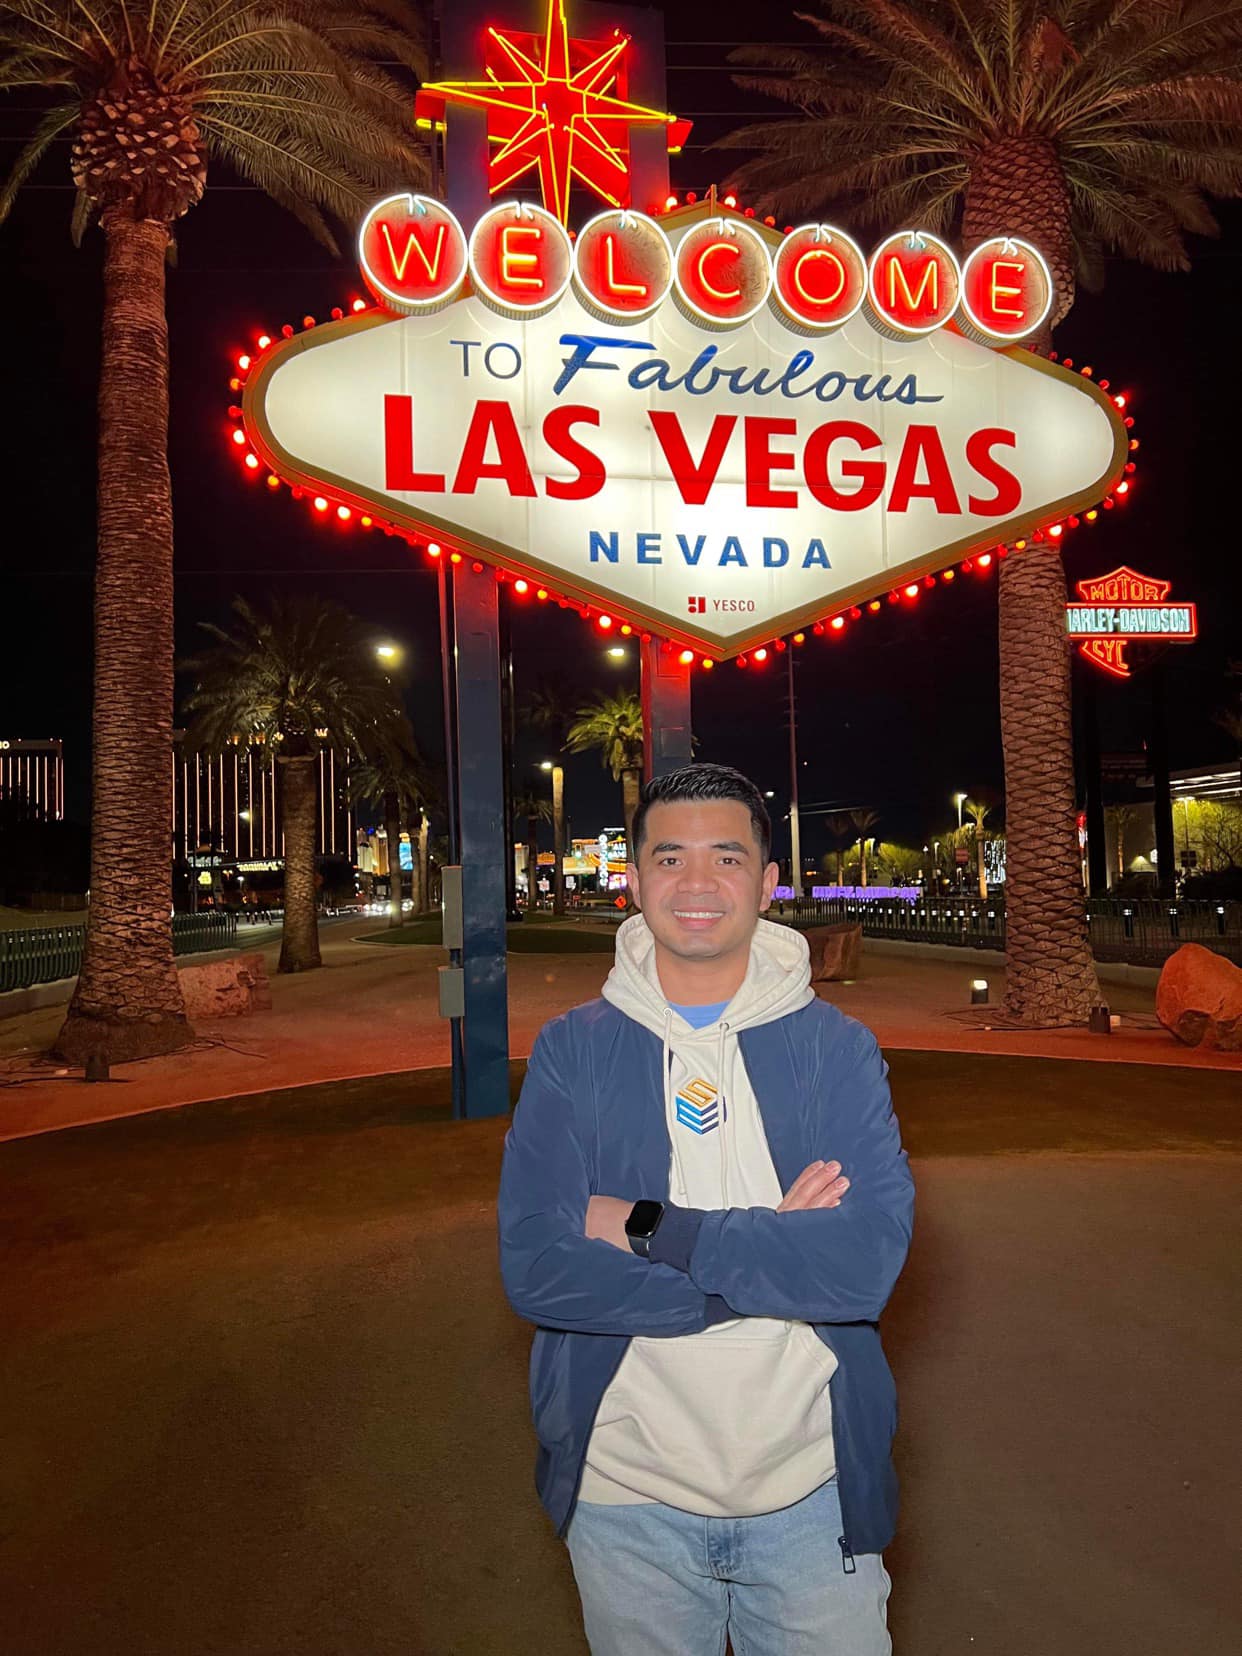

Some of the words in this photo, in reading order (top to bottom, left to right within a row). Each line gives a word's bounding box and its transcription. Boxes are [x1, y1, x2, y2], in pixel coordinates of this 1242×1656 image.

[375, 218, 1030, 324] WELCOME
[449, 339, 522, 380] TO
[553, 333, 945, 405] Fabulous
[384, 394, 608, 501] LAS
[647, 410, 1025, 518] VEGAS
[588, 530, 832, 570] NEVADA
[713, 599, 756, 612] YESCO
[1090, 574, 1159, 601] MOTOR
